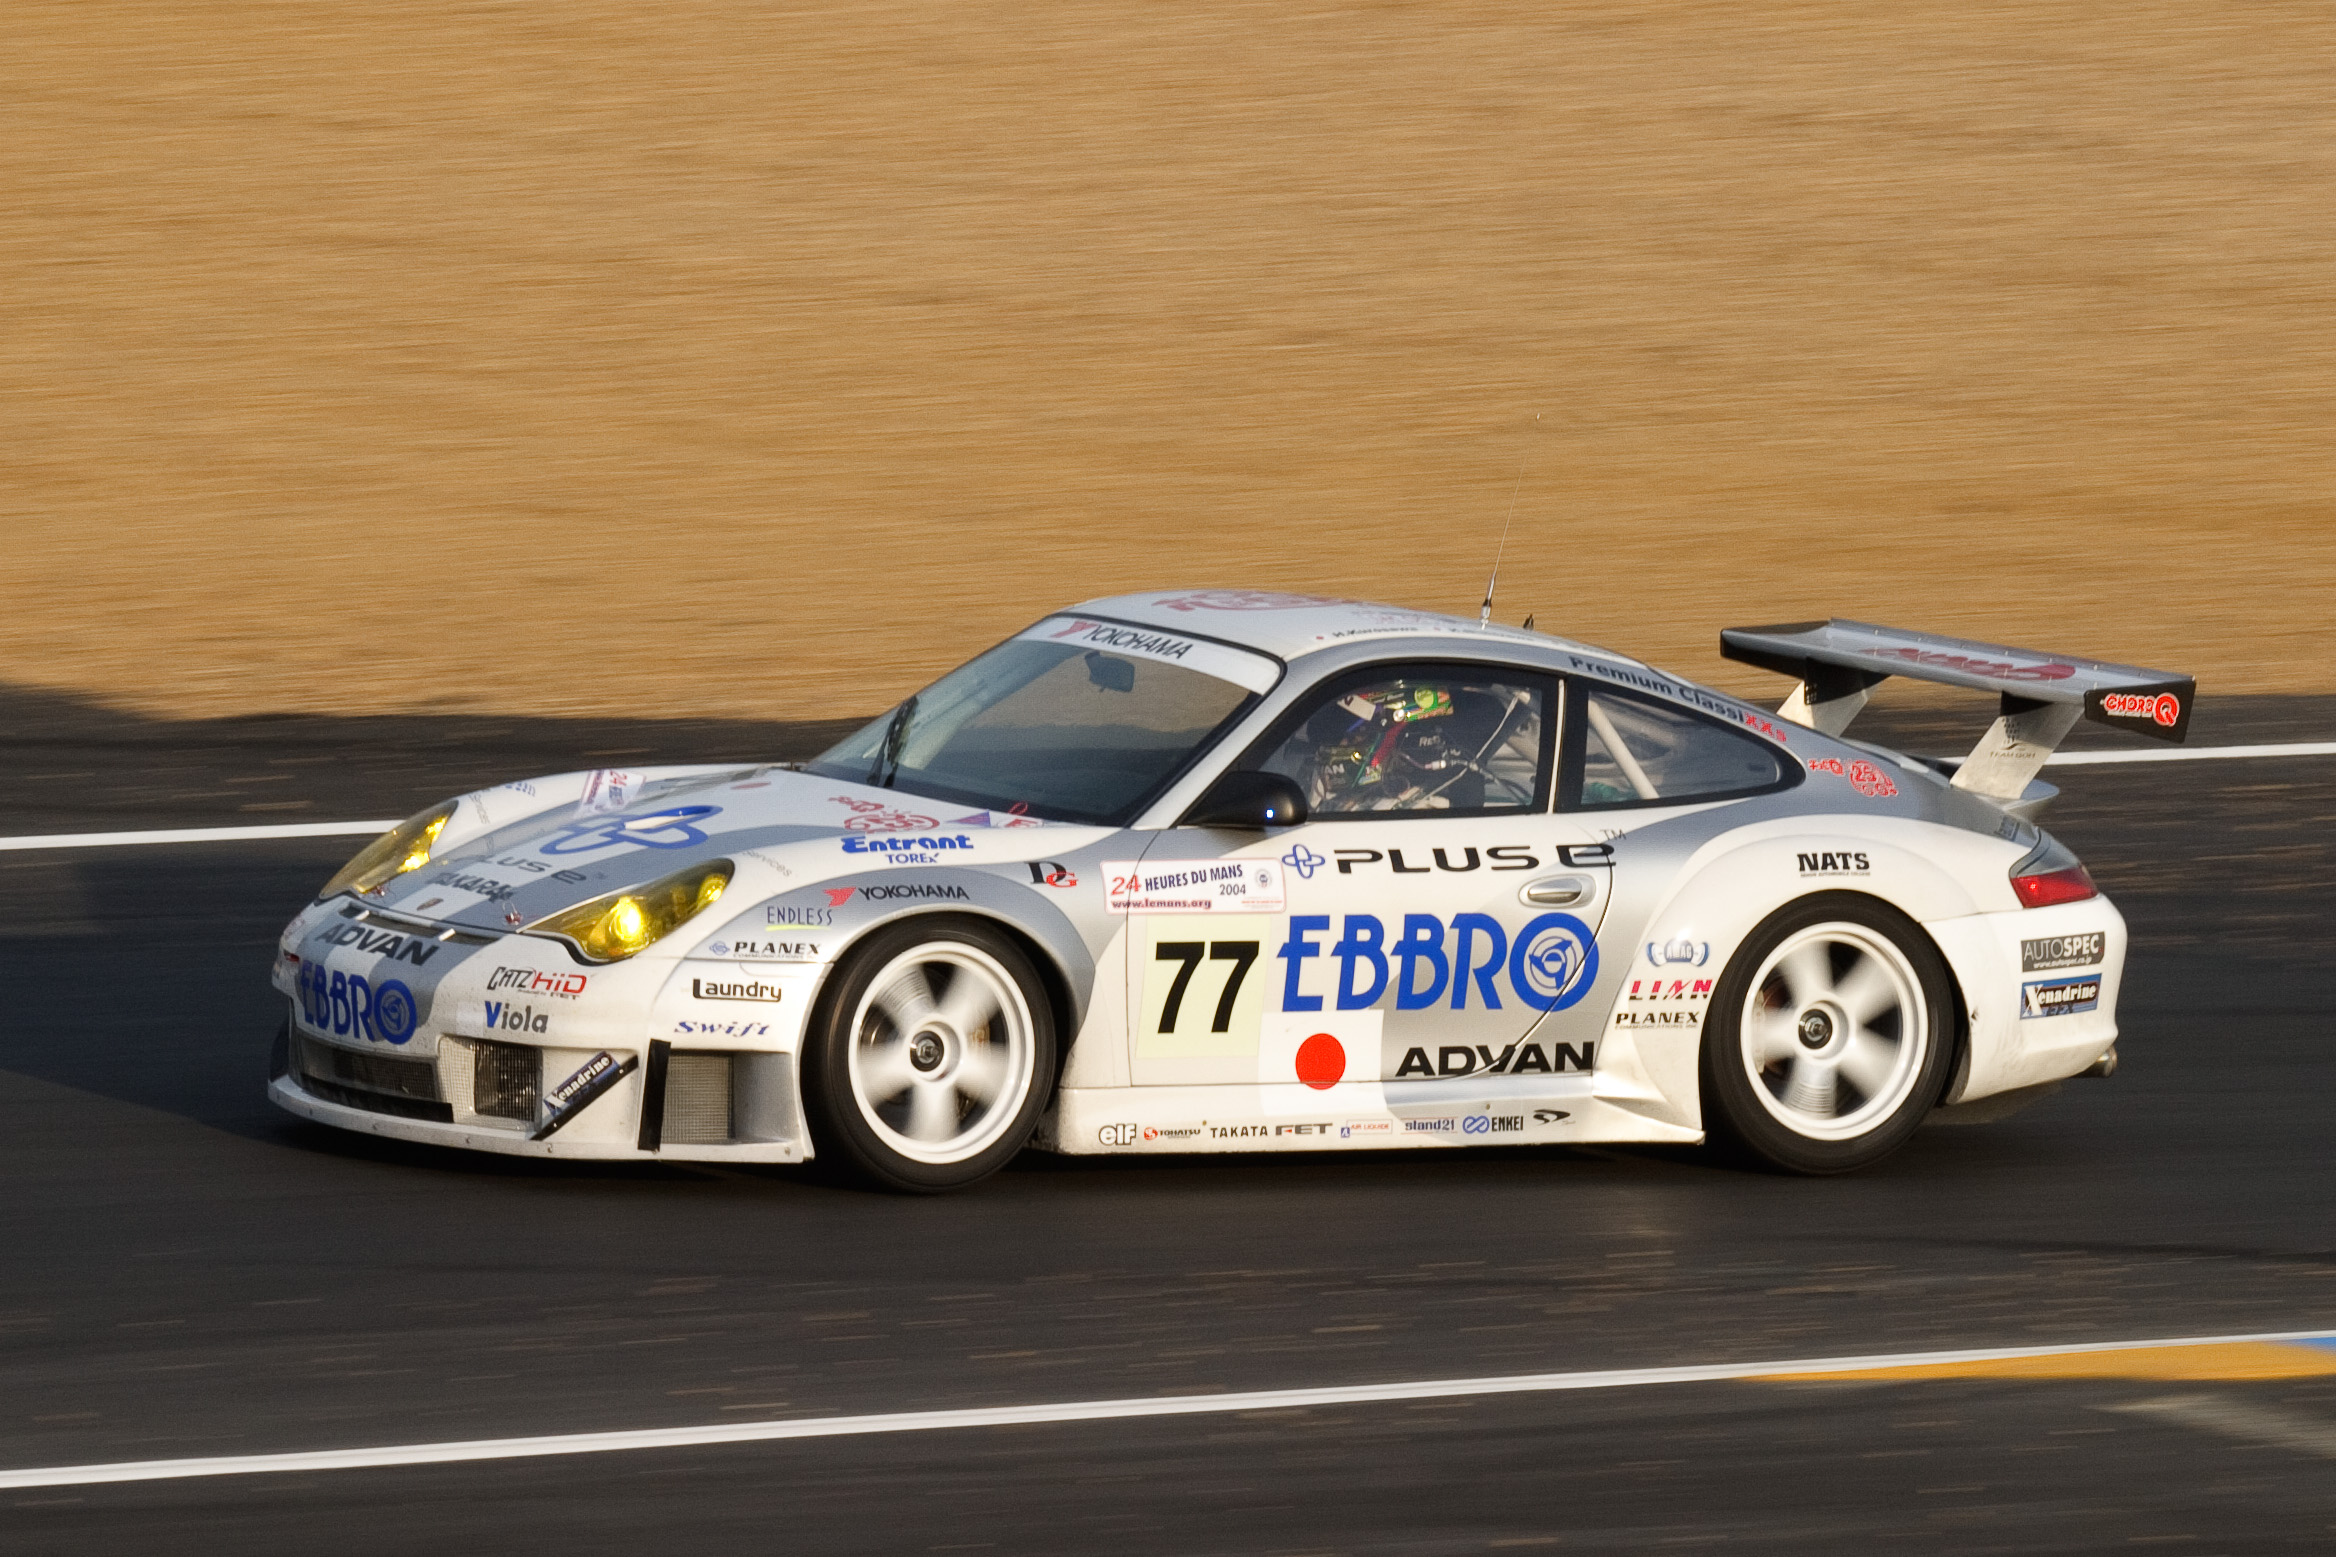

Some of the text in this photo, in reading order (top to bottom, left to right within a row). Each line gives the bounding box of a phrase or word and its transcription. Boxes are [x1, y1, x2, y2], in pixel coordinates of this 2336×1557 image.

[1083, 624, 1193, 659] YOKOHAMA
[1571, 656, 1672, 695] Premium
[841, 835, 974, 853] Entrant
[1334, 846, 1540, 874] PLUS
[1797, 852, 1869, 871] NATS
[1111, 864, 1243, 895] 24 HEURES DU MANS
[1220, 884, 1246, 895] 2004
[858, 885, 970, 900] YOKOHAMA
[1111, 898, 1212, 909] www.lemans.org
[767, 906, 833, 926] ENDLESS
[314, 923, 439, 966] ADVAN
[733, 941, 821, 954] PLANEX
[2024, 934, 2099, 962] AUTOSPEC
[1277, 912, 1599, 1012] EBBRO
[692, 979, 782, 1002] Laundry
[1155, 941, 1260, 1033] 77
[301, 959, 417, 1045] EBBRO
[2022, 984, 2097, 1017] Xenadrine
[484, 1001, 549, 1033] Viola
[674, 1021, 770, 1037] Swift
[1615, 1012, 1699, 1024] PLANEX
[1395, 1041, 1594, 1077] ADVAN
[544, 1055, 611, 1109] Xenadrine
[1098, 1123, 1136, 1146] elf
[1210, 1126, 1268, 1138] TAKATA
[1491, 1116, 1524, 1131] ENKEI
